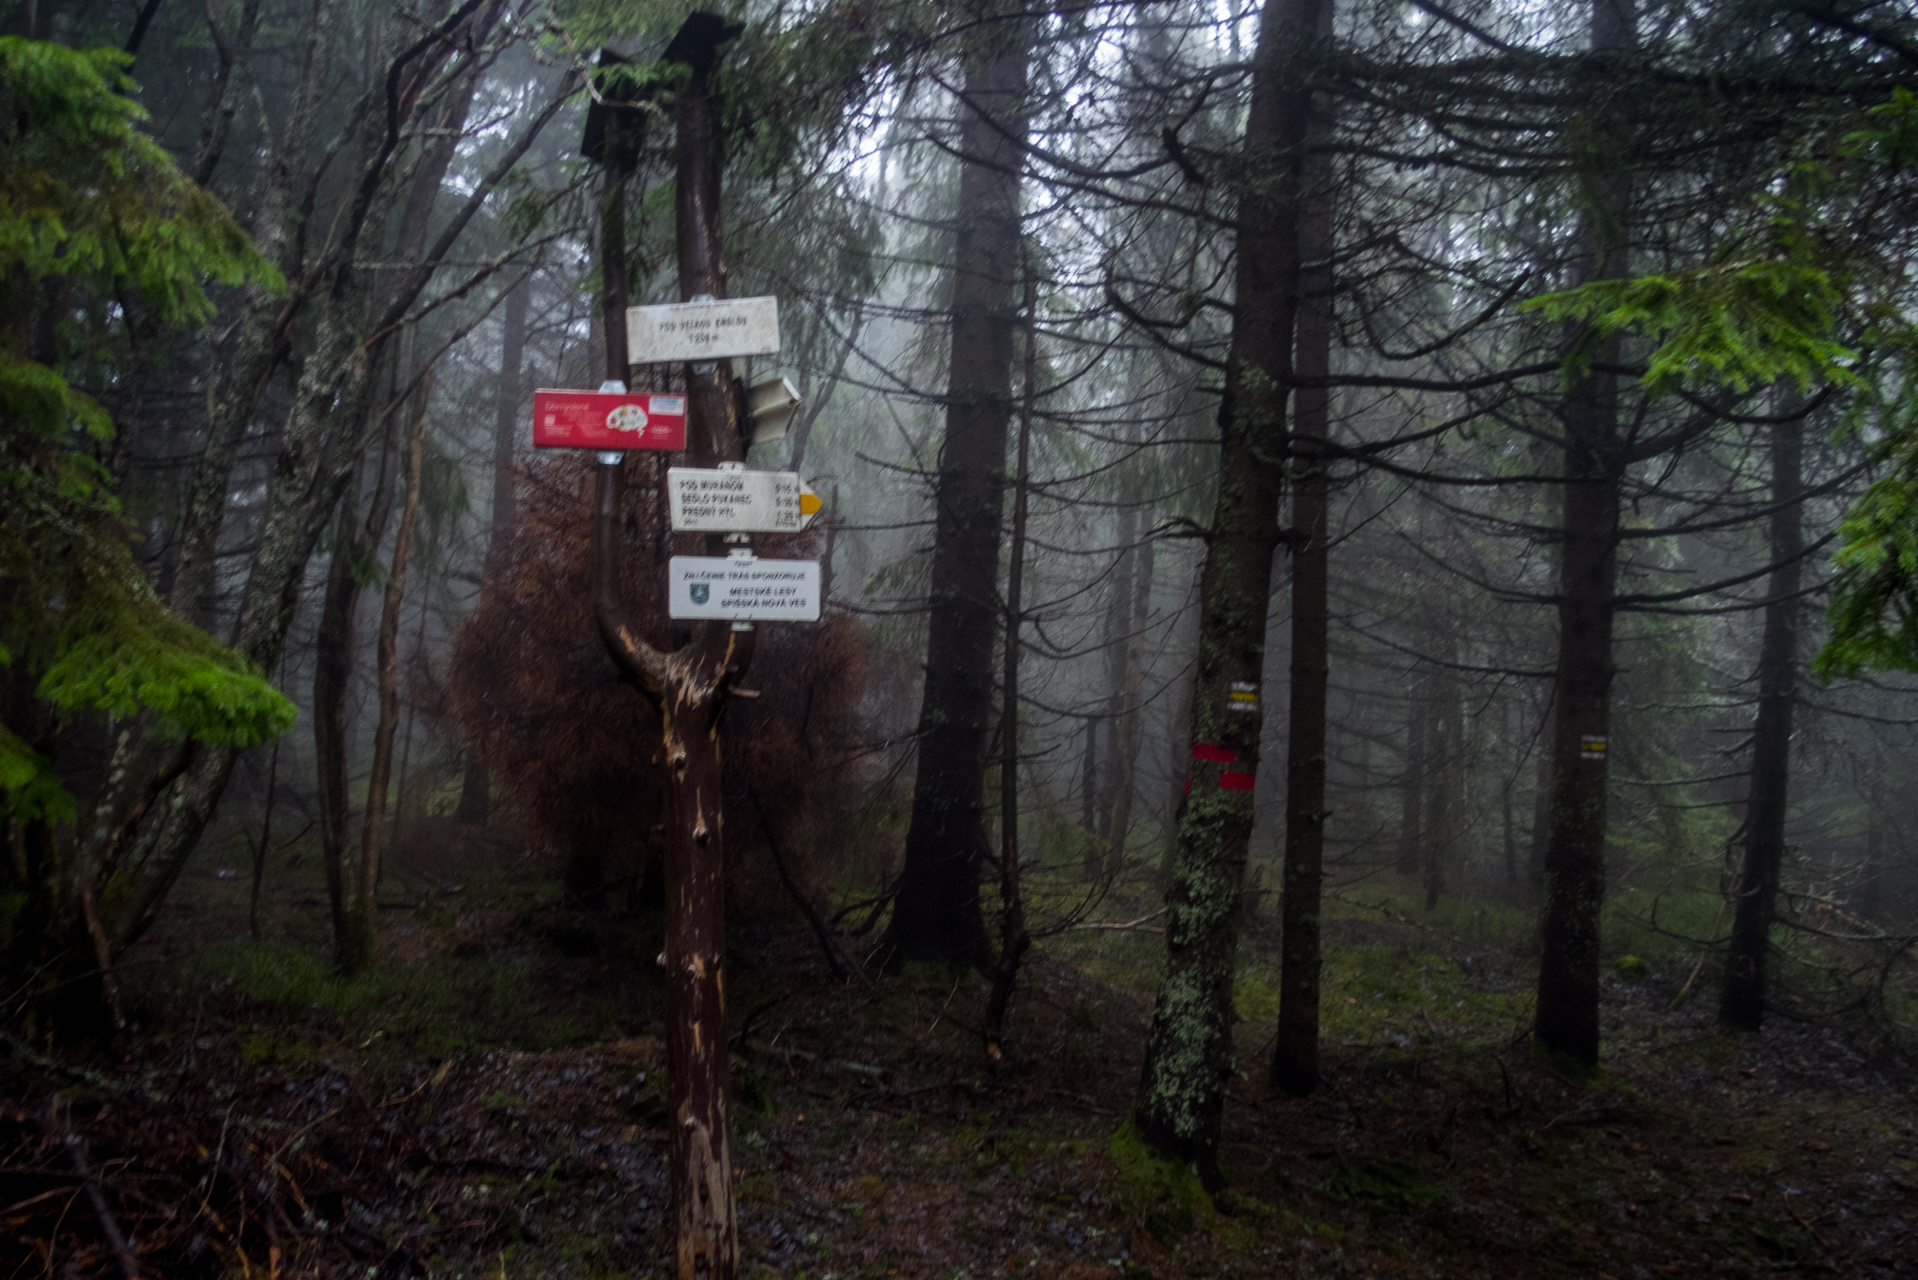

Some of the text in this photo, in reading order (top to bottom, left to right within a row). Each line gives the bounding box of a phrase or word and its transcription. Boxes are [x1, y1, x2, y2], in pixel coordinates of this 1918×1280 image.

[679, 480, 698, 491] POD
[681, 494, 710, 505] SEDLO
[752, 571, 806, 581] SPONZORUJE
[730, 585, 797, 596] MESTSKÉ LESY
[789, 598, 806, 608] VES
